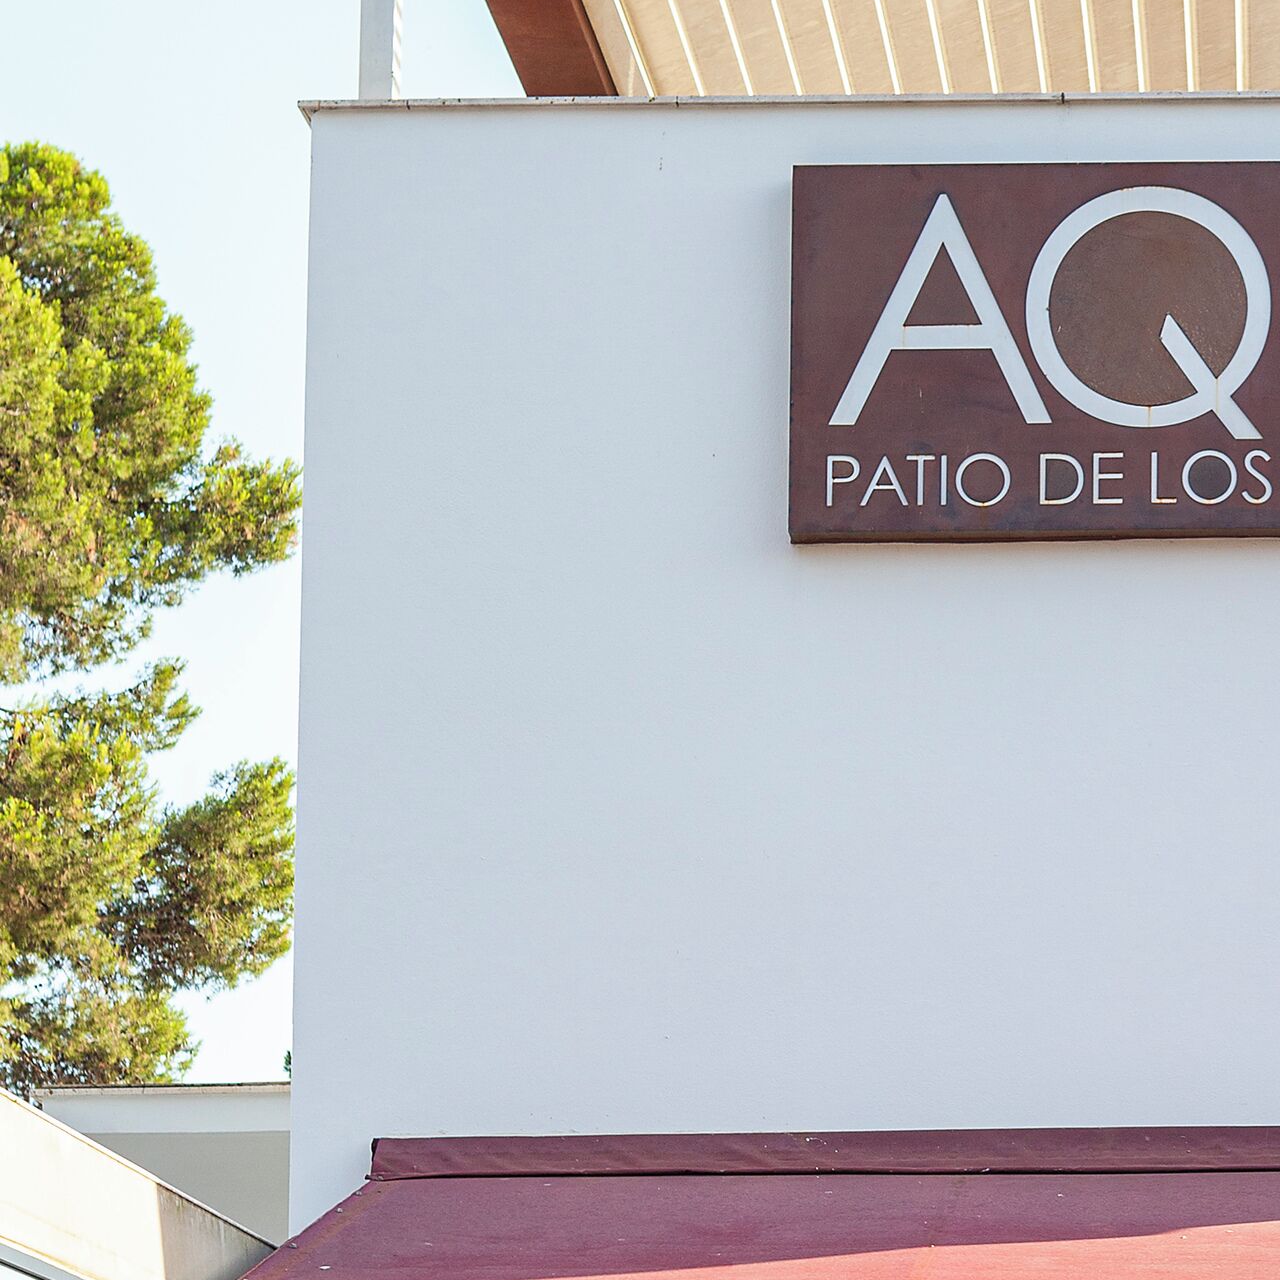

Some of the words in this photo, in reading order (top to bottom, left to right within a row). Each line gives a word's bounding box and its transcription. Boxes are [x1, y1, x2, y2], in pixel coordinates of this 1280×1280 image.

[829, 186, 1272, 440] AQ
[826, 453, 1011, 507] PATIO
[1039, 452, 1124, 505] DE
[1150, 449, 1273, 505] LOS
